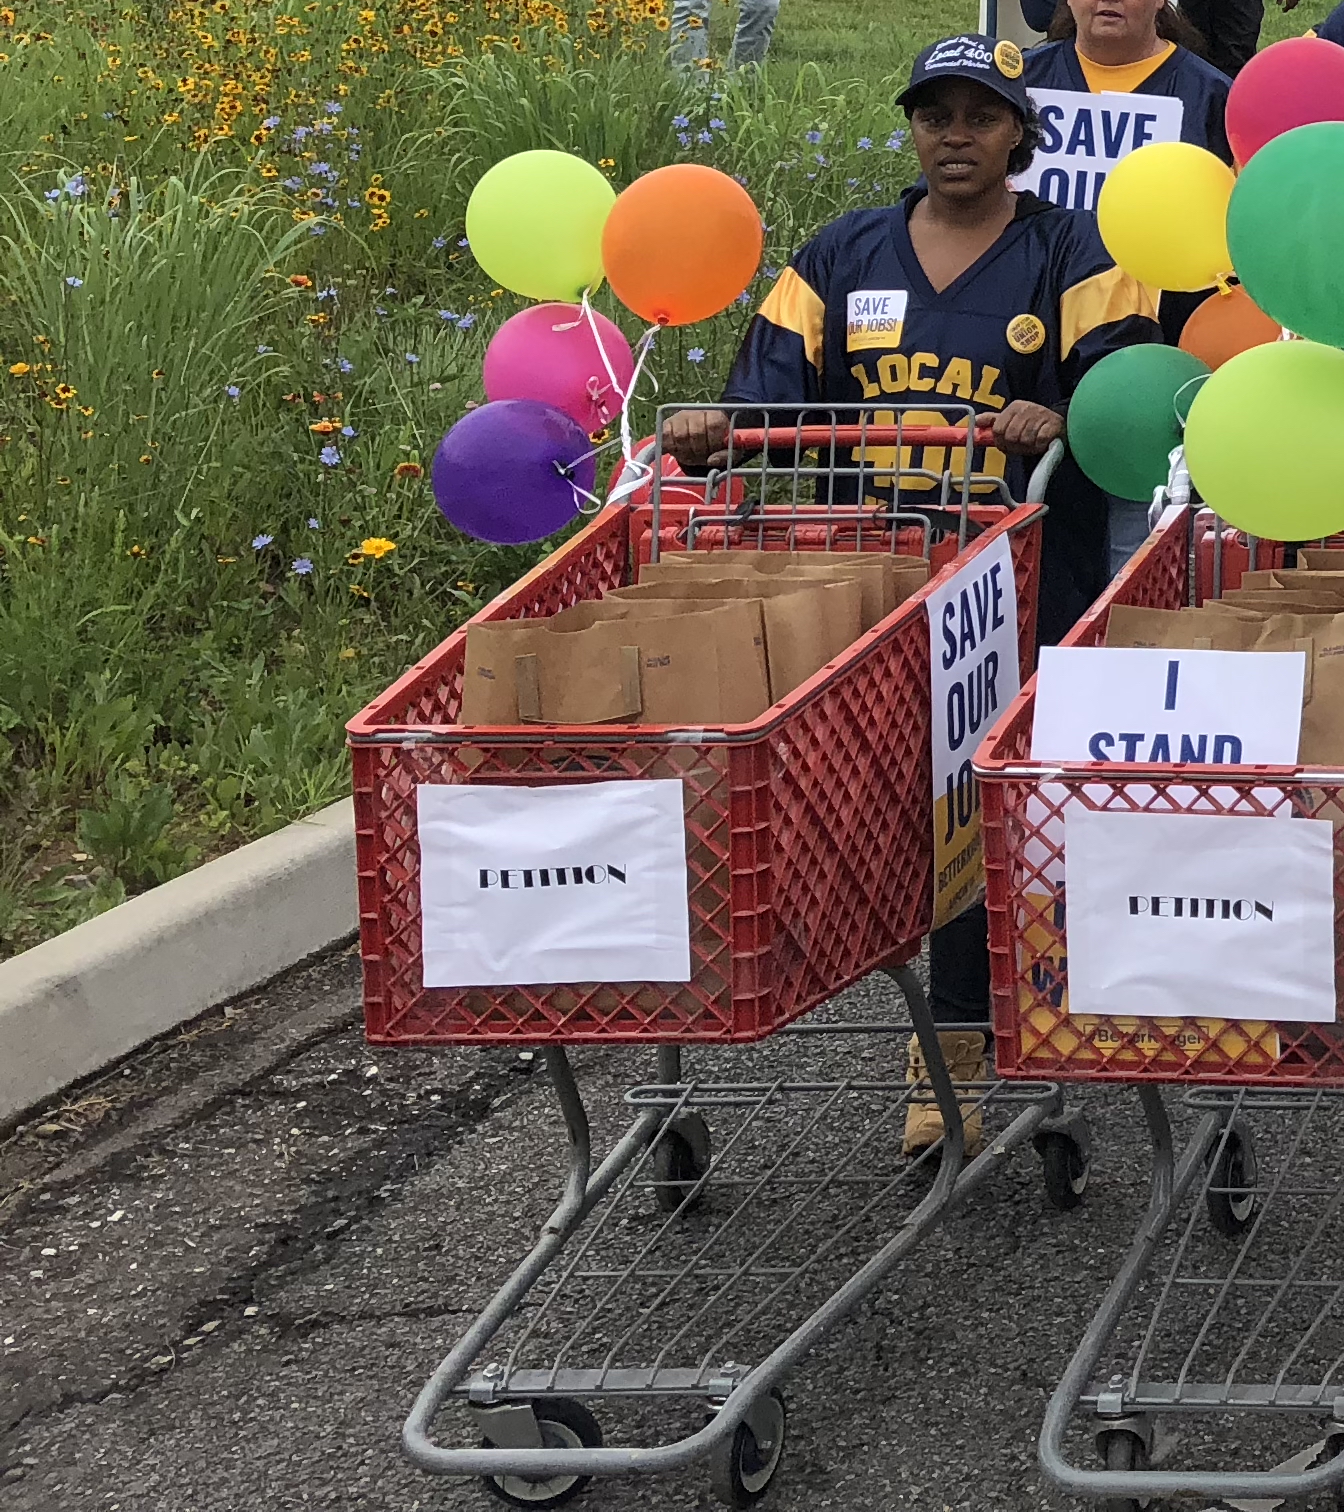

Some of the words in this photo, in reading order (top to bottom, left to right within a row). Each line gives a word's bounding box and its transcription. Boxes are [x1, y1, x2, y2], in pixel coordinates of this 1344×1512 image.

[925, 45, 965, 65] Local
[964, 48, 993, 63] 400
[1038, 105, 1157, 159] SAVE
[854, 297, 891, 316] SAVE
[866, 318, 897, 333] JOBS!
[1012, 323, 1038, 343] UNION
[851, 352, 1006, 409] LOCAL
[942, 561, 1004, 670] SAVE
[946, 650, 998, 751] OUR
[1164, 660, 1179, 710] I
[1088, 731, 1242, 764] STAND
[944, 758, 981, 845] JO
[479, 864, 627, 889] PETITION
[1129, 894, 1274, 922] PETITION
